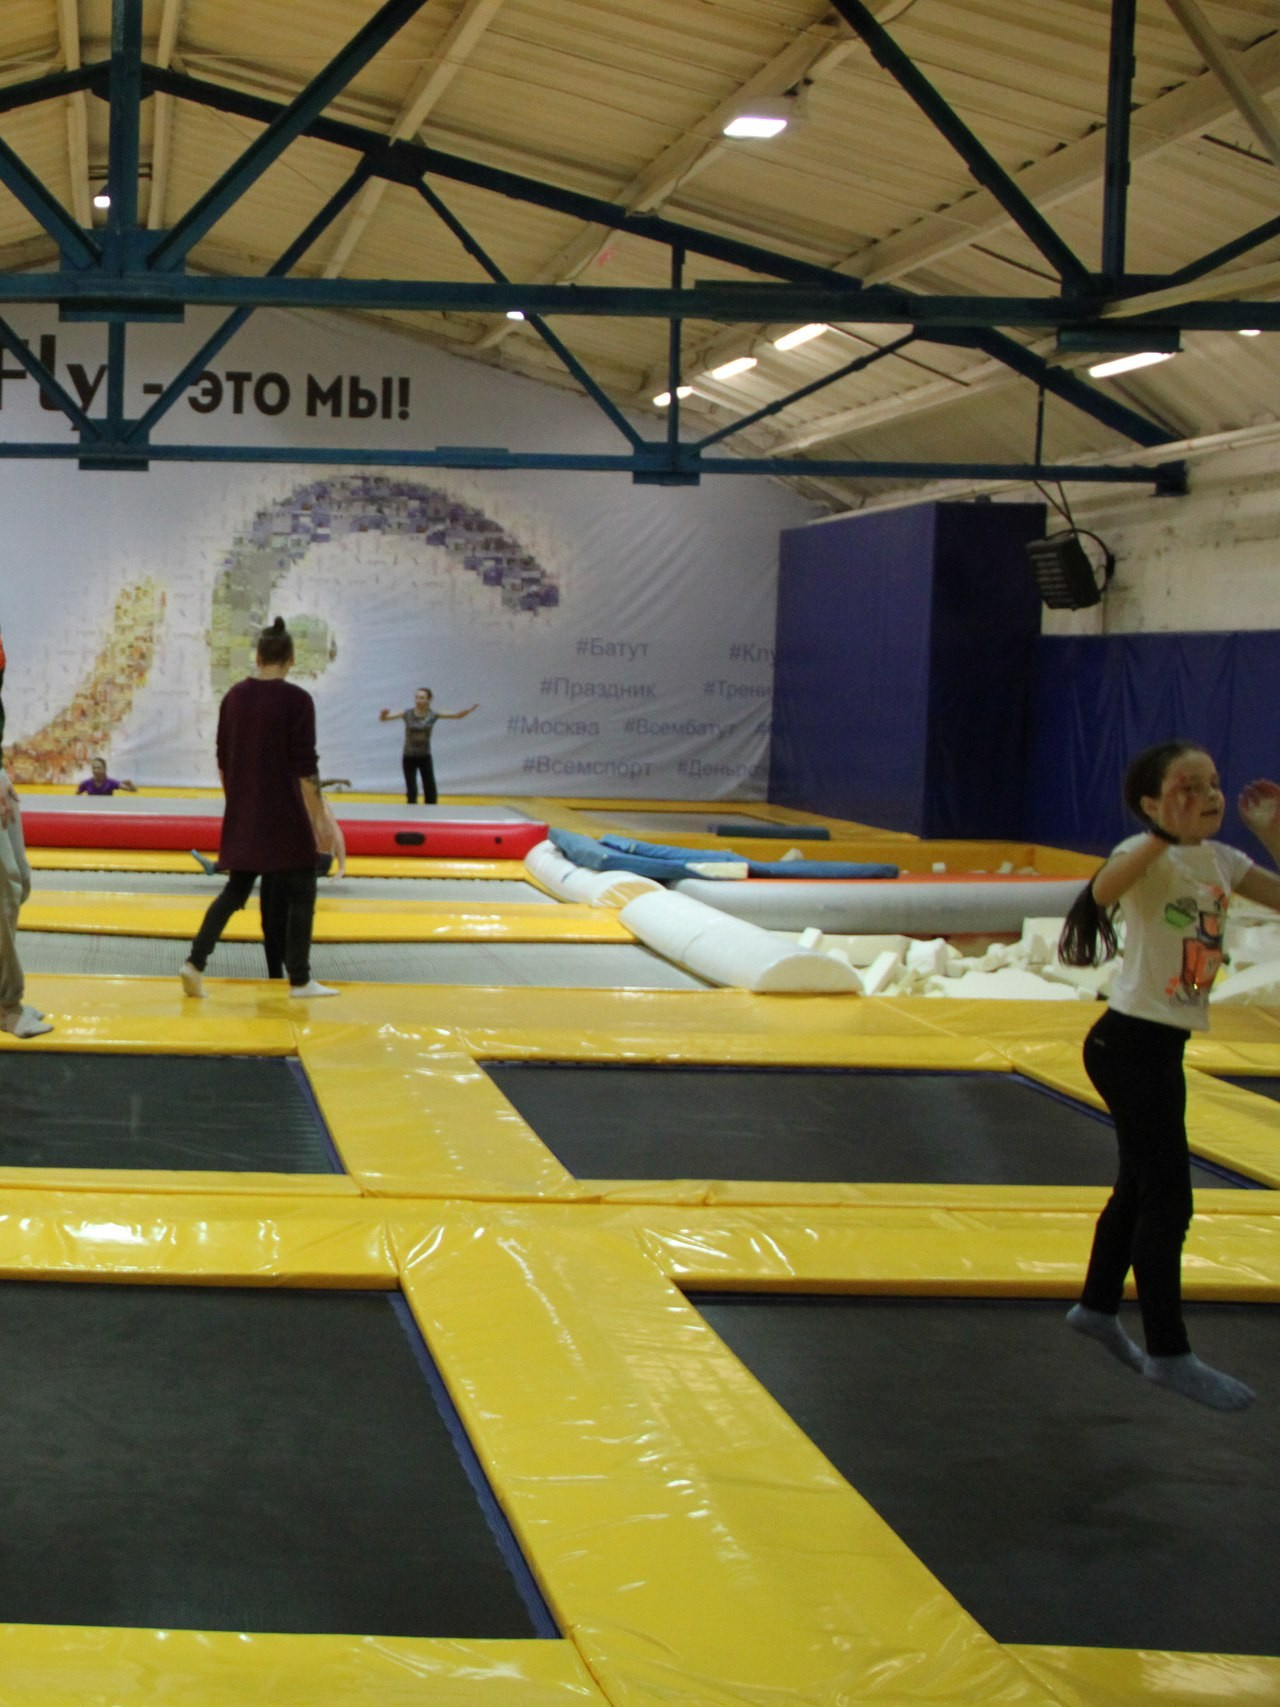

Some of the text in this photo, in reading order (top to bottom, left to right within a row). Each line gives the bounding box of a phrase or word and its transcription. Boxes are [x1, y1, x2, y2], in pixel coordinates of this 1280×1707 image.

[575, 638, 650, 661] #Батут
[540, 677, 657, 702] #Праздник
[507, 715, 600, 737] #Москва
[523, 756, 652, 781] #Всемспорт
